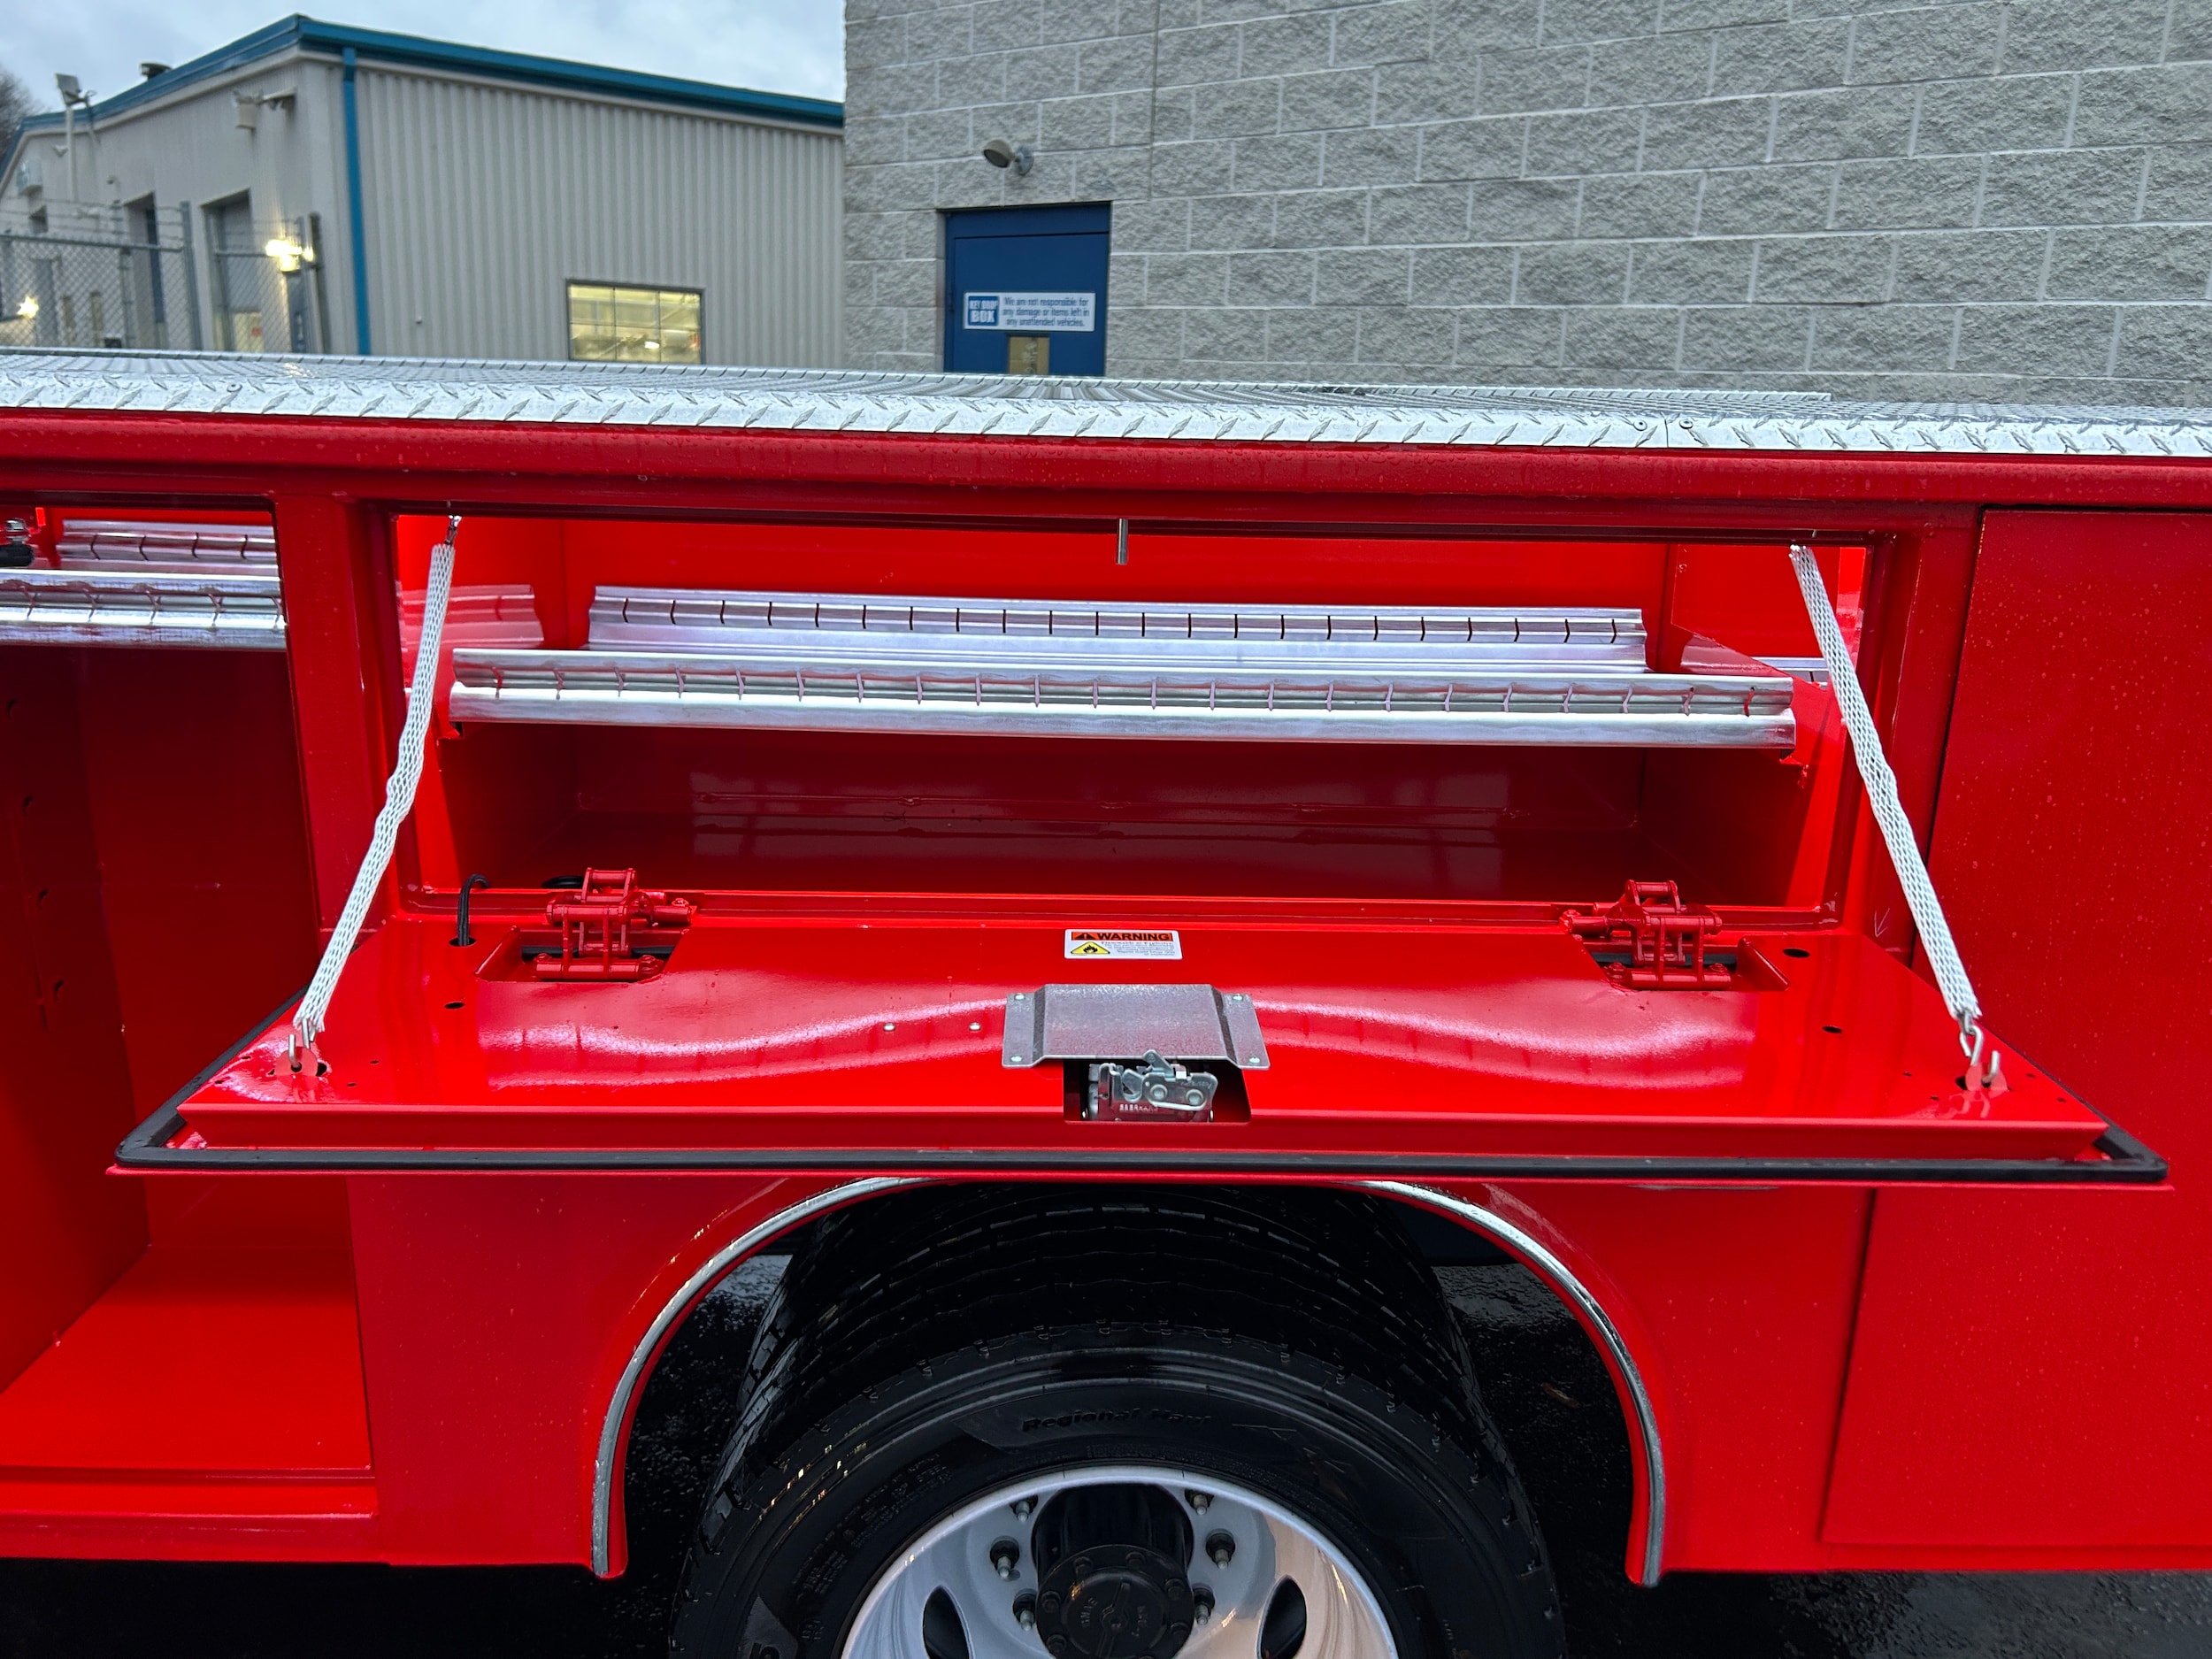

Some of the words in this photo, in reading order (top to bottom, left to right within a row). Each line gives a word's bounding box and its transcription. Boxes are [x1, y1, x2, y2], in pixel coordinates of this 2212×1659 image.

[1004, 296, 1015, 306] We
[1028, 297, 1039, 306] not
[1040, 297, 1077, 308] responsible
[1079, 297, 1089, 307] for
[970, 310, 995, 323] BOX
[1002, 308, 1014, 318] any
[1016, 307, 1041, 318] damage
[1051, 308, 1070, 317] items
[1071, 307, 1082, 317] left
[1083, 308, 1089, 317] in
[1006, 319, 1018, 327] any
[1019, 318, 1056, 326] unattended
[1056, 318, 1085, 327] vehicles.
[1022, 1408, 1141, 1432] Regional
[1151, 1408, 1211, 1425] Haul
